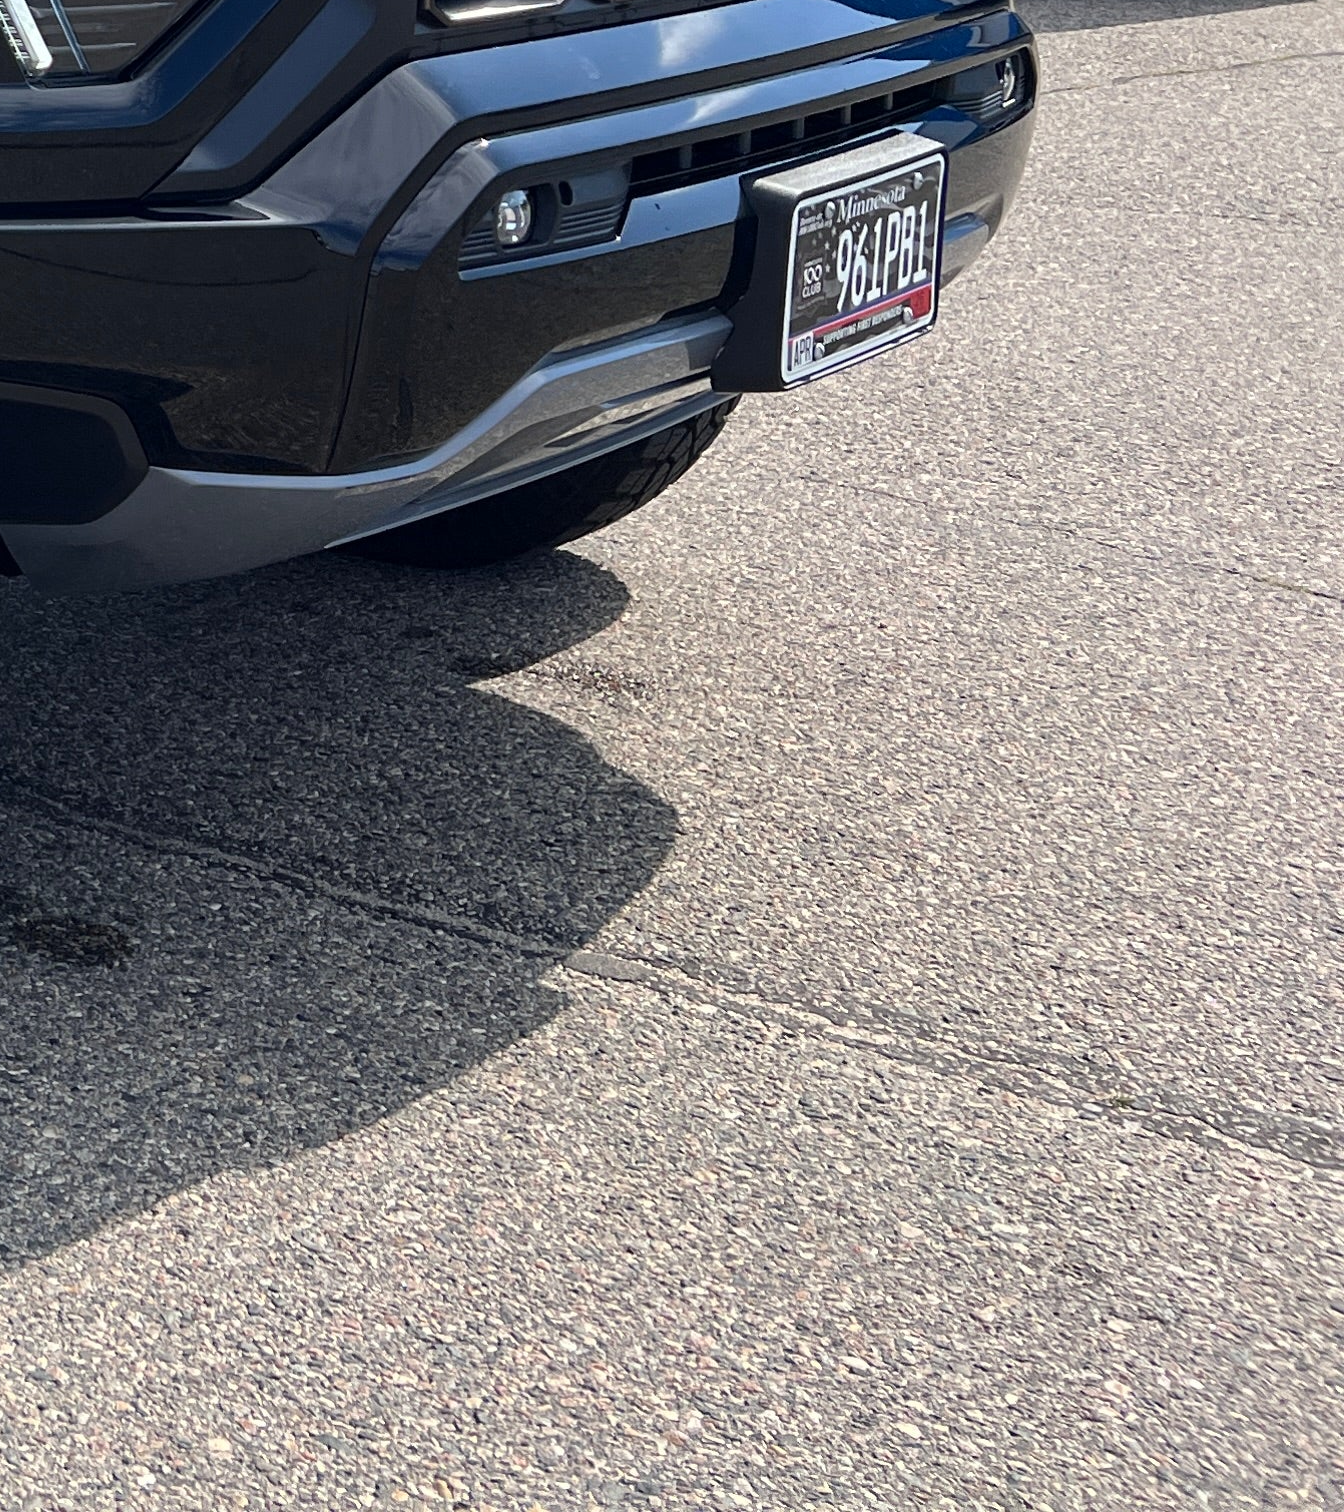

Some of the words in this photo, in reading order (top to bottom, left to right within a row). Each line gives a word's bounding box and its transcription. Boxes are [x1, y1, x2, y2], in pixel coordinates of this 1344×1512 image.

[837, 185, 907, 224] Minnesota
[837, 200, 928, 314] 961PB1
[802, 282, 822, 299] CLUB
[794, 335, 813, 367] APR
